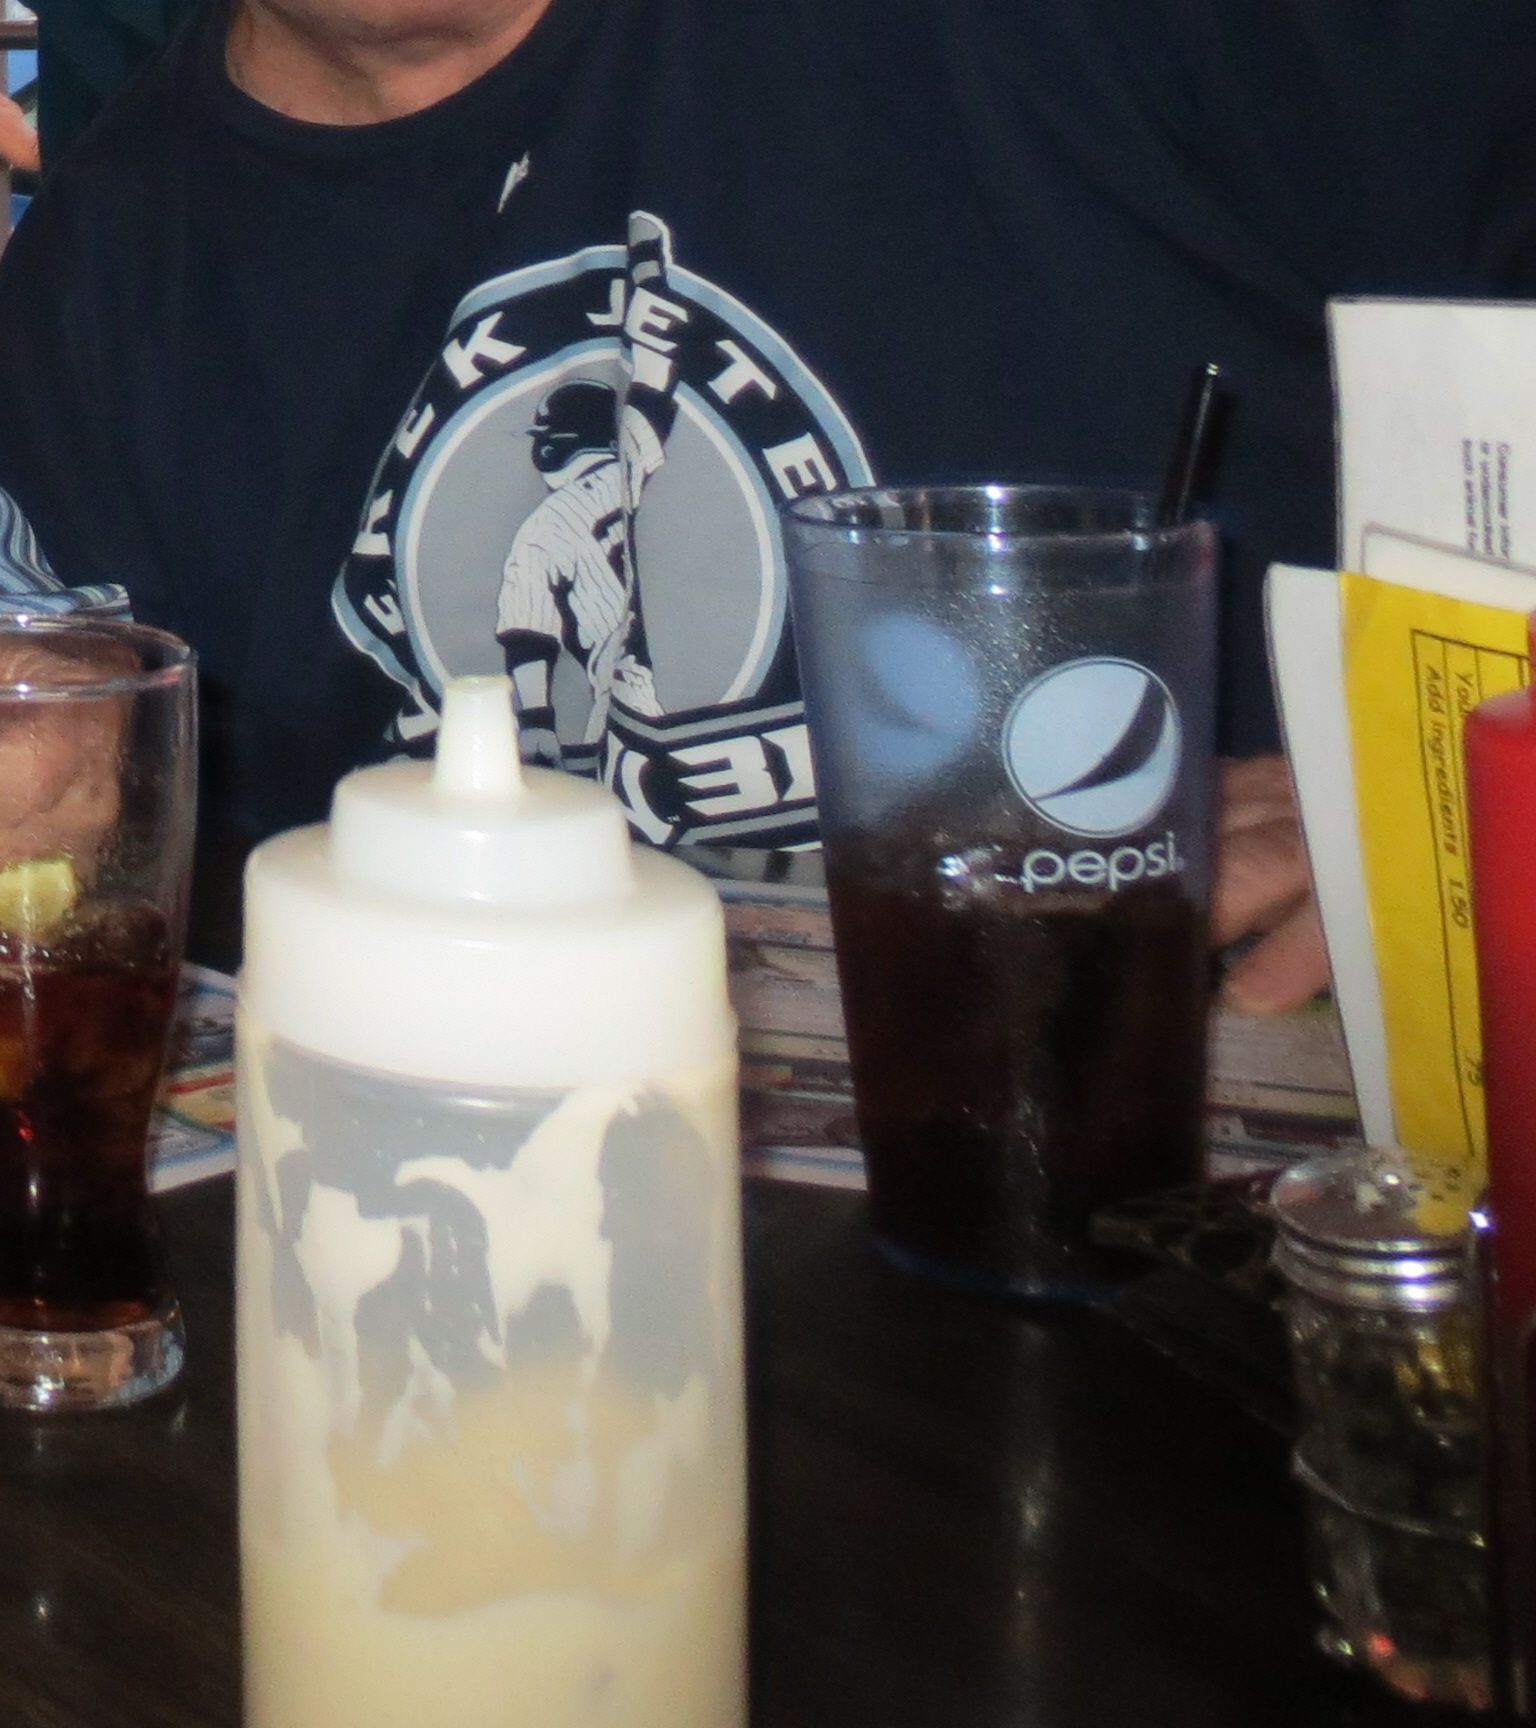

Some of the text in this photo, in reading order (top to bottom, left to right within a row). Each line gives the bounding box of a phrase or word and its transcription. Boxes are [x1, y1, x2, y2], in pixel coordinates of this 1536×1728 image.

[584, 278, 836, 501] JETE
[1426, 665, 1446, 718] Add
[1429, 721, 1458, 856] ingredients
[1021, 831, 1178, 892] pepsi
